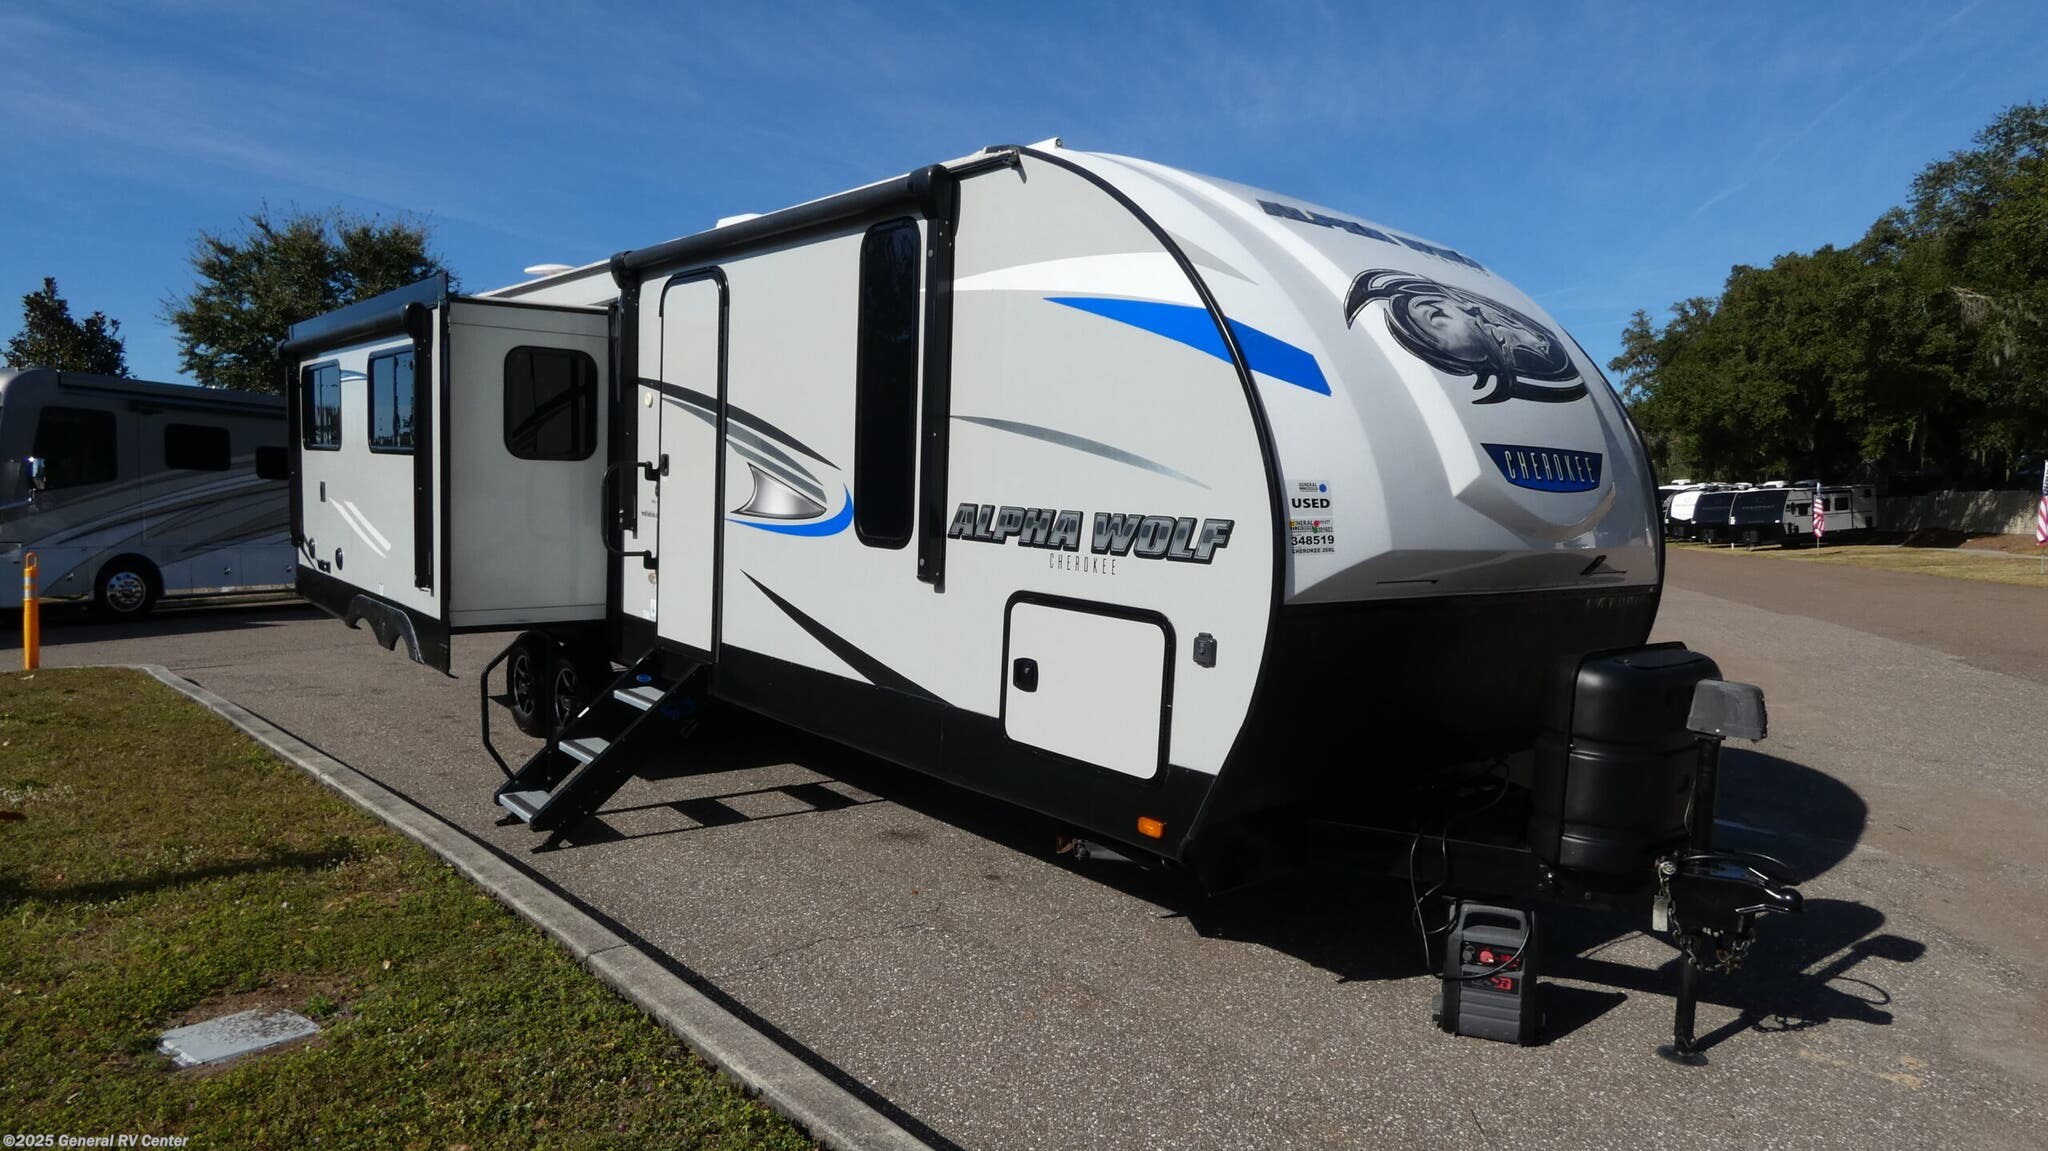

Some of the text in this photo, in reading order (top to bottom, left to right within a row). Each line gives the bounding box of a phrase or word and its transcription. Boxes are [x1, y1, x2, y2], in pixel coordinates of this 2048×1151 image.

[1504, 450, 1596, 483] CHEROKEE
[1291, 498, 1330, 509] USED
[948, 502, 1235, 565] ALPHA WOLF
[1291, 535, 1335, 546] 348519
[1049, 552, 1117, 576] CHEROKEE
